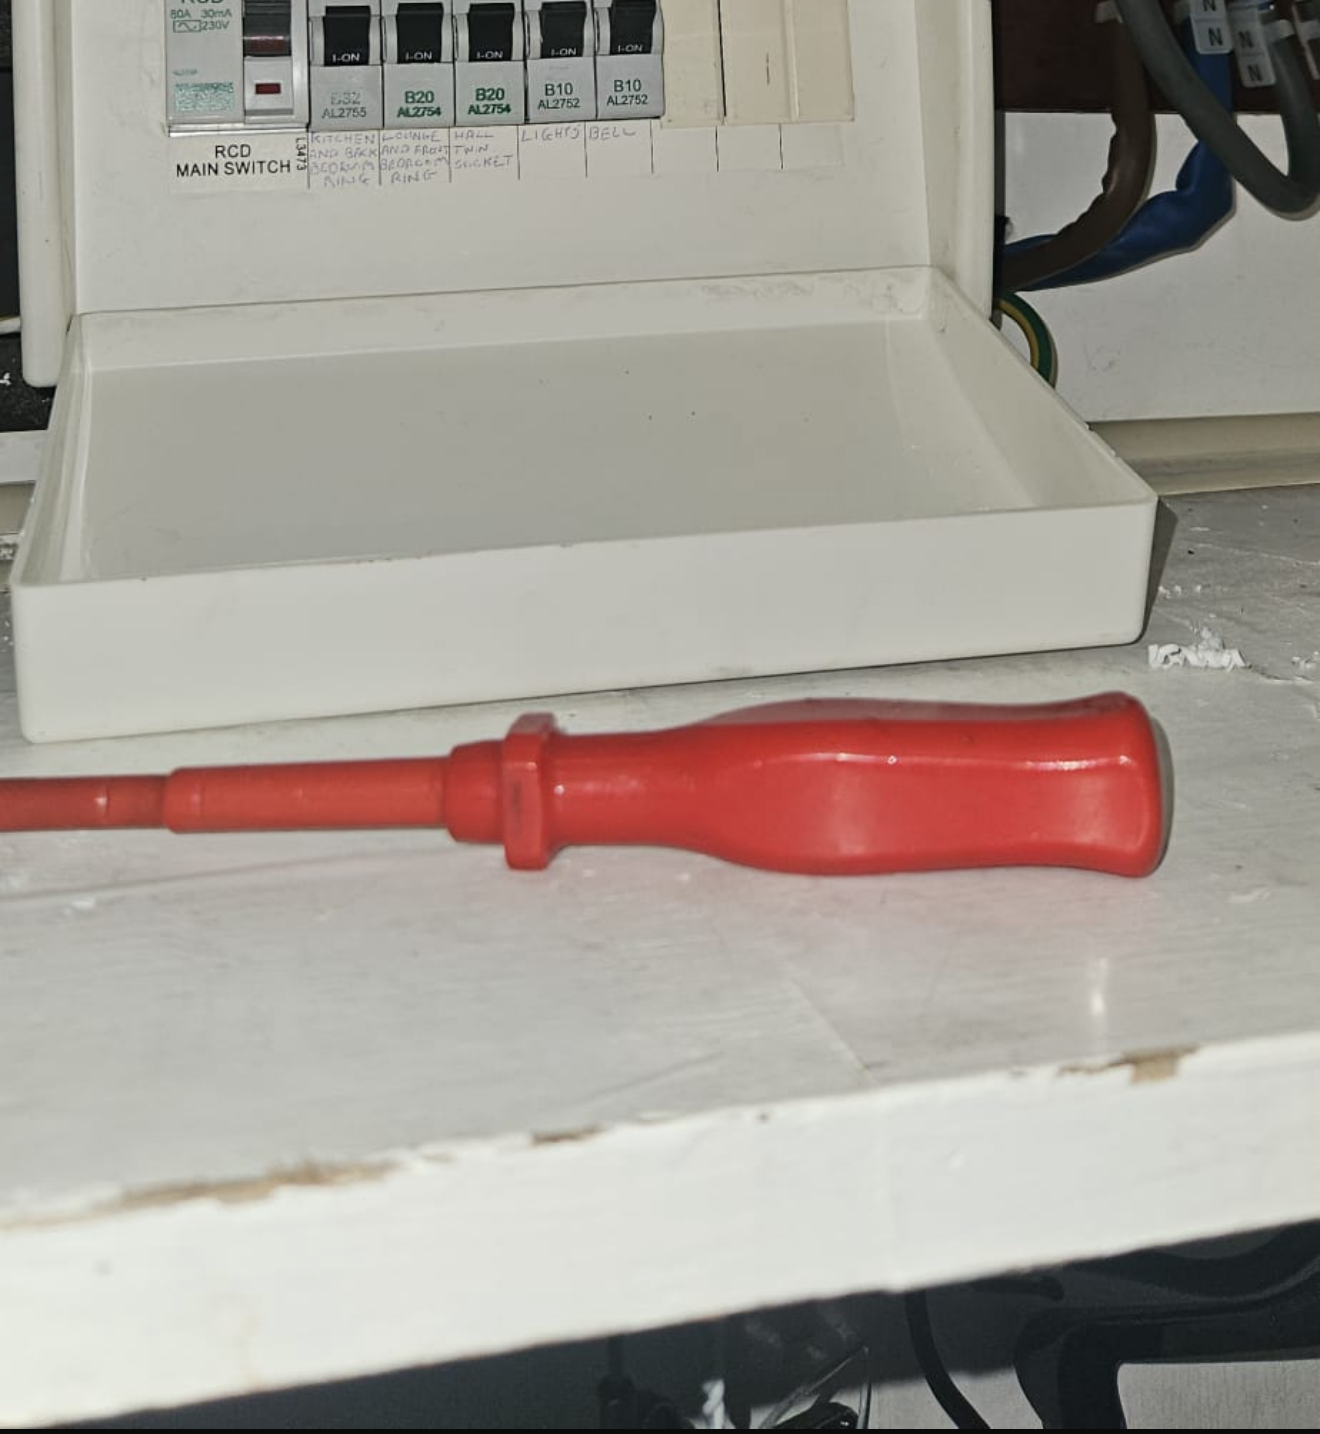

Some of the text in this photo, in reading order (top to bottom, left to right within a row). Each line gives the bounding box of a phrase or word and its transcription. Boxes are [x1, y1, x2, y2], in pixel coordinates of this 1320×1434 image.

[201, 9, 232, 19] 30mA
[201, 20, 230, 31] 230V
[1208, 27, 1223, 46] N
[1238, 31, 1253, 48] N
[1247, 64, 1262, 81] N
[545, 83, 573, 96] B10
[613, 79, 641, 92] B10
[405, 91, 435, 104] B20
[475, 87, 505, 101] B20
[606, 94, 648, 106] AL2752
[468, 103, 511, 115] AL2754
[537, 97, 580, 109] AL2752
[322, 107, 367, 119] AL2755
[397, 106, 441, 118] AL2754
[311, 132, 375, 145] KITCHEN
[382, 131, 441, 142] LOUNGE
[454, 130, 494, 140] HALL
[215, 144, 252, 158] RCD
[381, 145, 410, 156] AND
[176, 160, 291, 177] MAIN SWITCH
[324, 173, 370, 188] RING
[391, 171, 437, 184] RING
